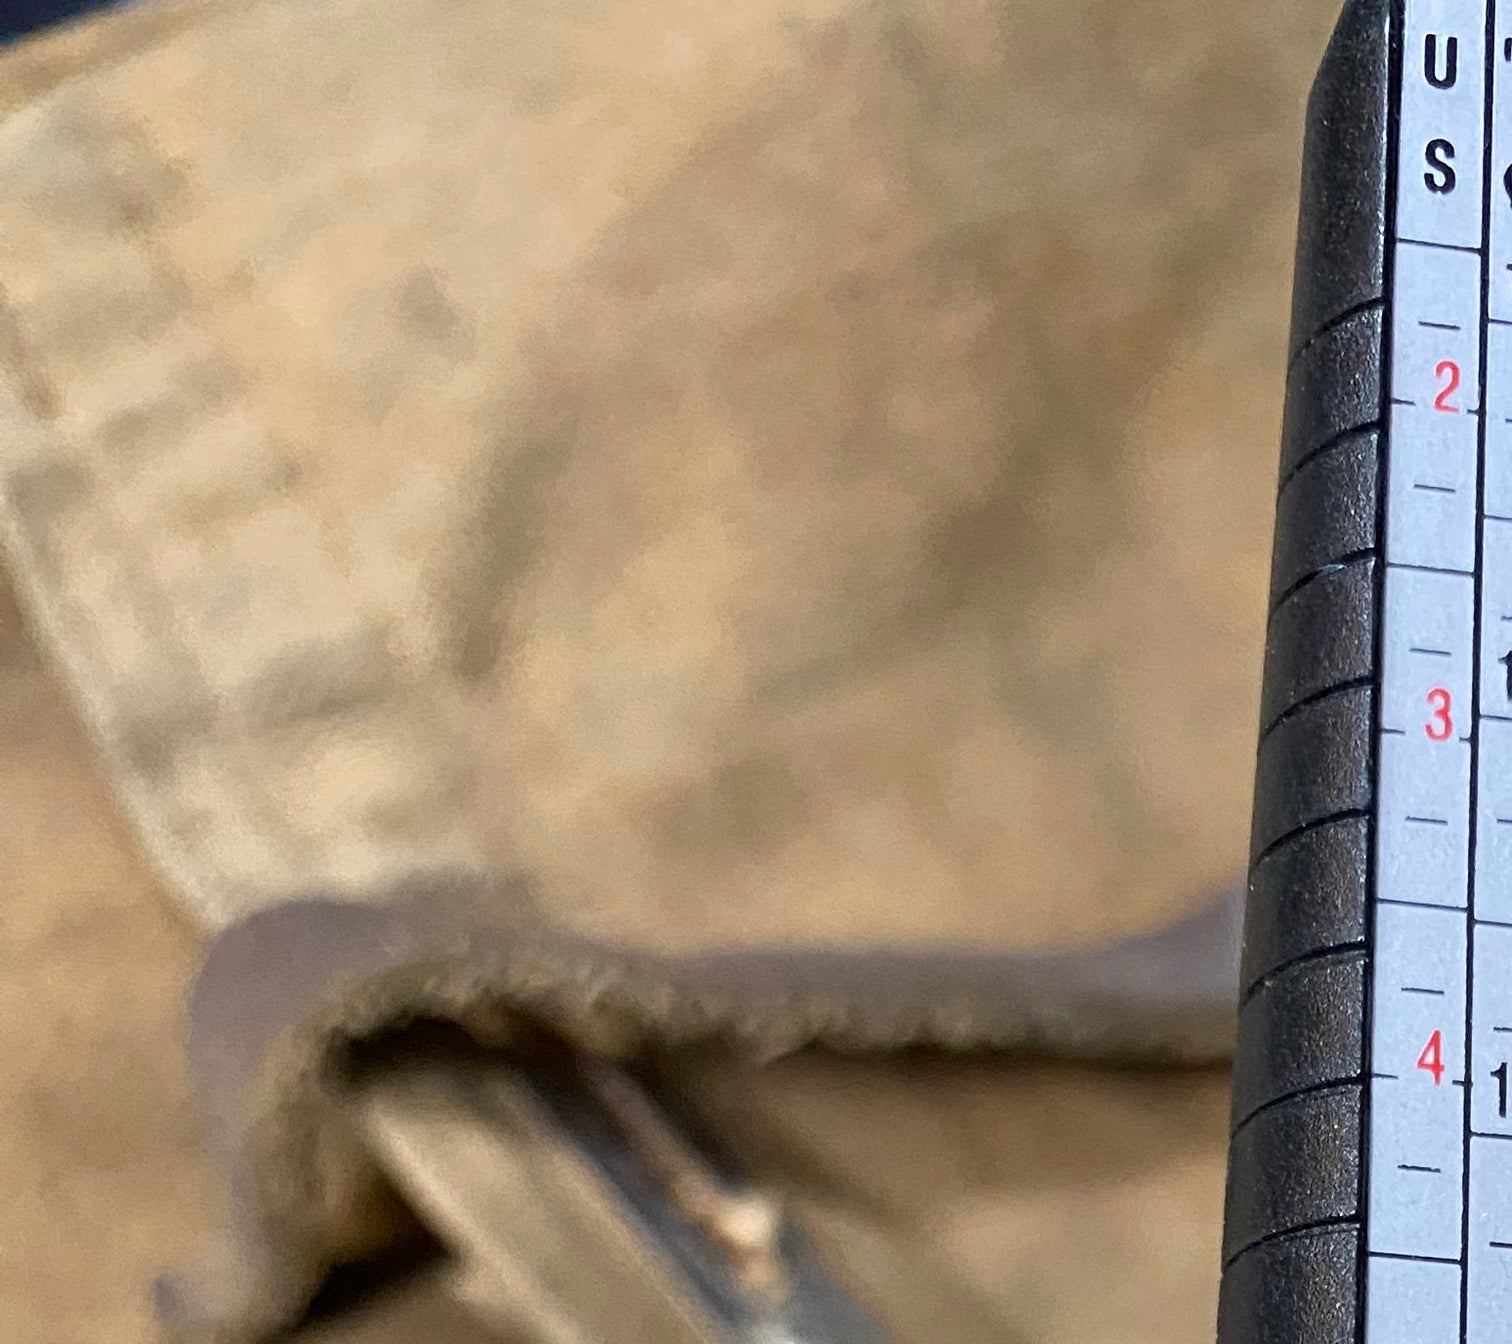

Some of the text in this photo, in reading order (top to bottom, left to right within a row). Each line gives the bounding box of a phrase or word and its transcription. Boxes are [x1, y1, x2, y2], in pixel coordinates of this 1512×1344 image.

[1433, 361, 1460, 413] 2
[1425, 689, 1453, 741] 3
[1417, 1030, 1445, 1085] 4
